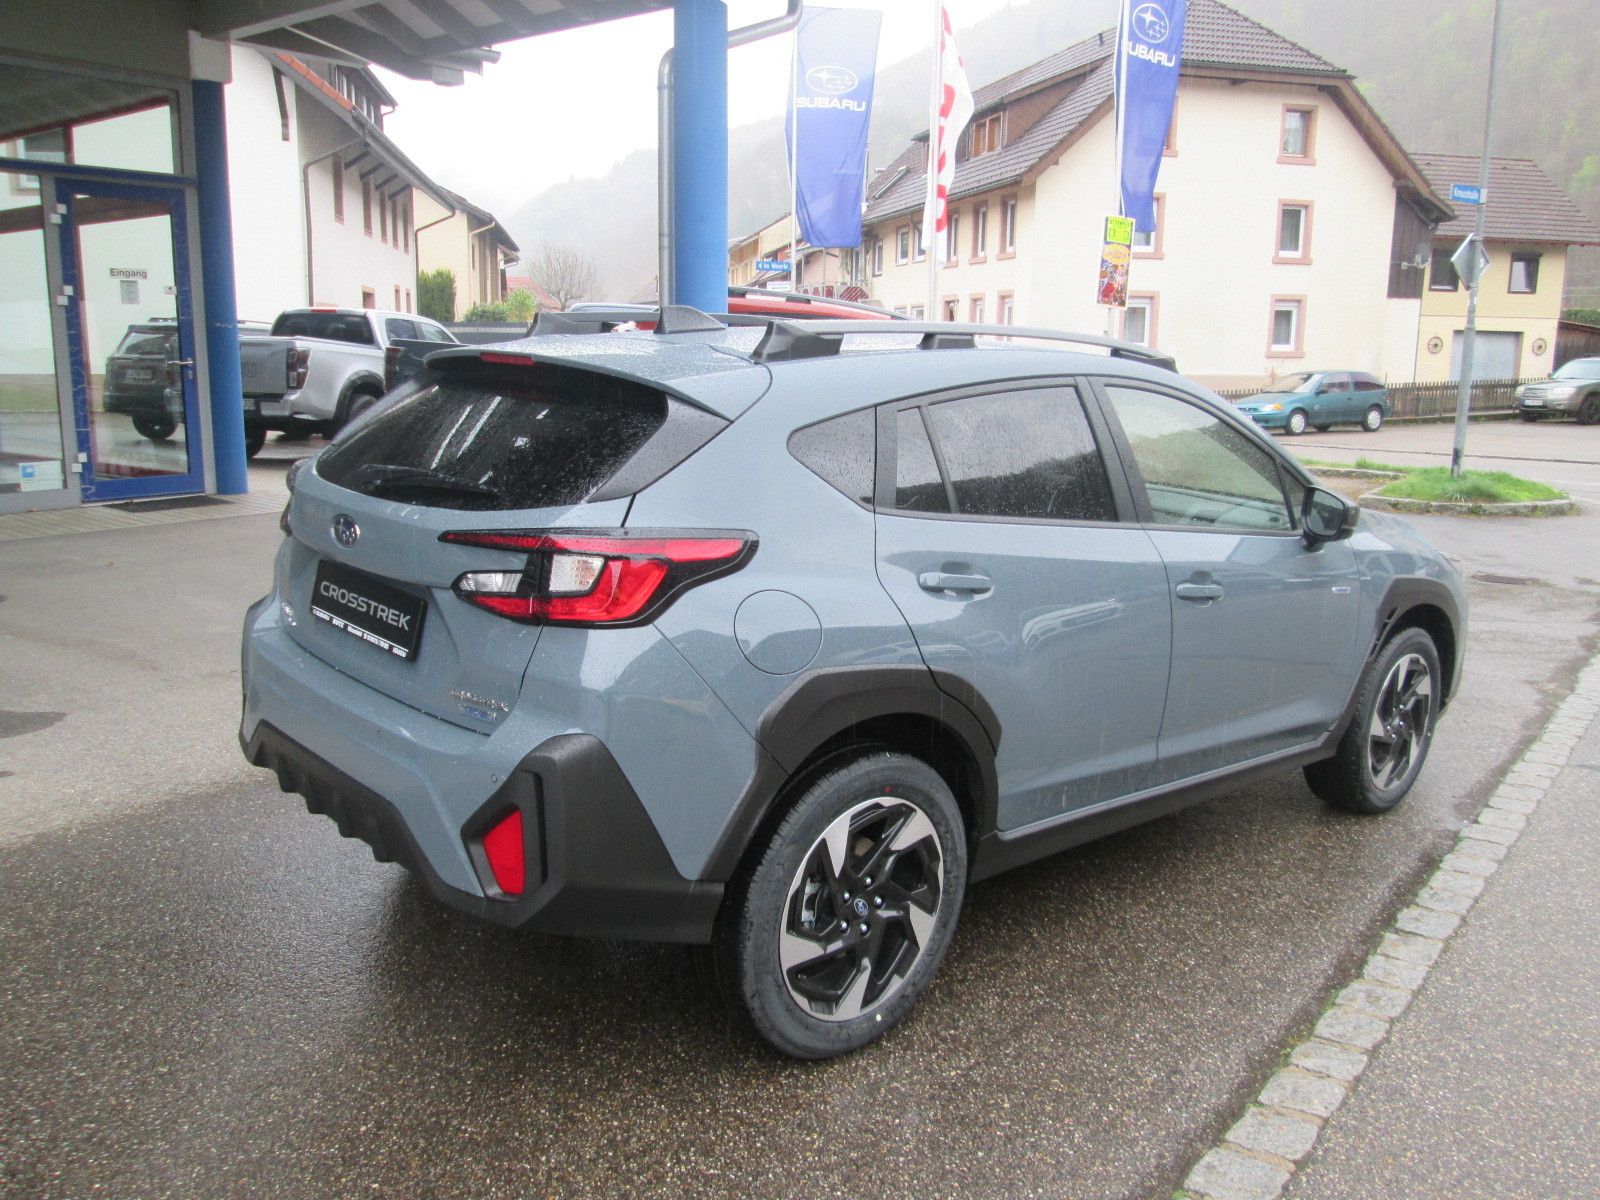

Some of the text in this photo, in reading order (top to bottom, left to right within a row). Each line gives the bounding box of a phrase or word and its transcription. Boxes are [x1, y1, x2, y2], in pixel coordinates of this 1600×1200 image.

[1127, 41, 1176, 68] UBARU
[796, 96, 867, 112] SUBARU
[110, 268, 148, 279] Eingang
[320, 581, 411, 631] CROSSTREK
